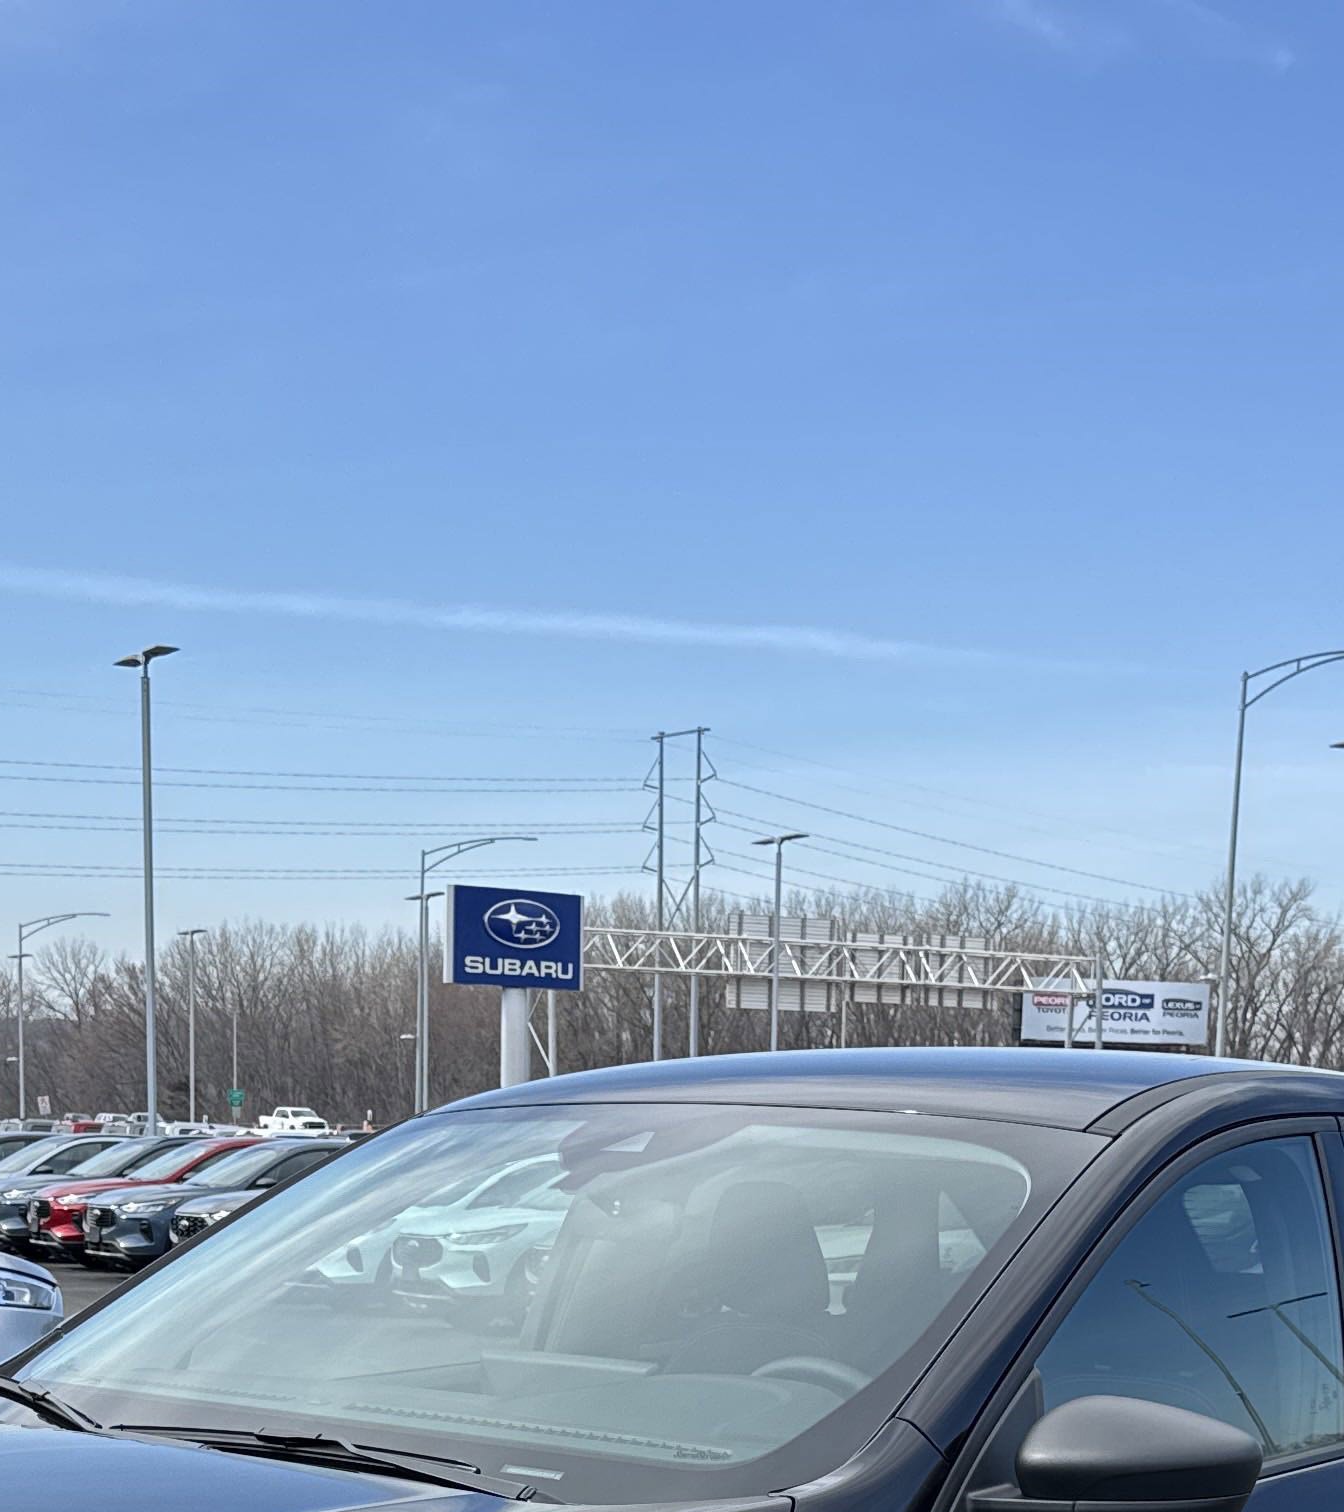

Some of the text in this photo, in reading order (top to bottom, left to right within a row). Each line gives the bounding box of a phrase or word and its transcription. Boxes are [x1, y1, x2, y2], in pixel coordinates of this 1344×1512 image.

[464, 956, 573, 980] SUBARU
[1033, 995, 1074, 1005] PEORI
[1036, 1007, 1068, 1015] TOYOT
